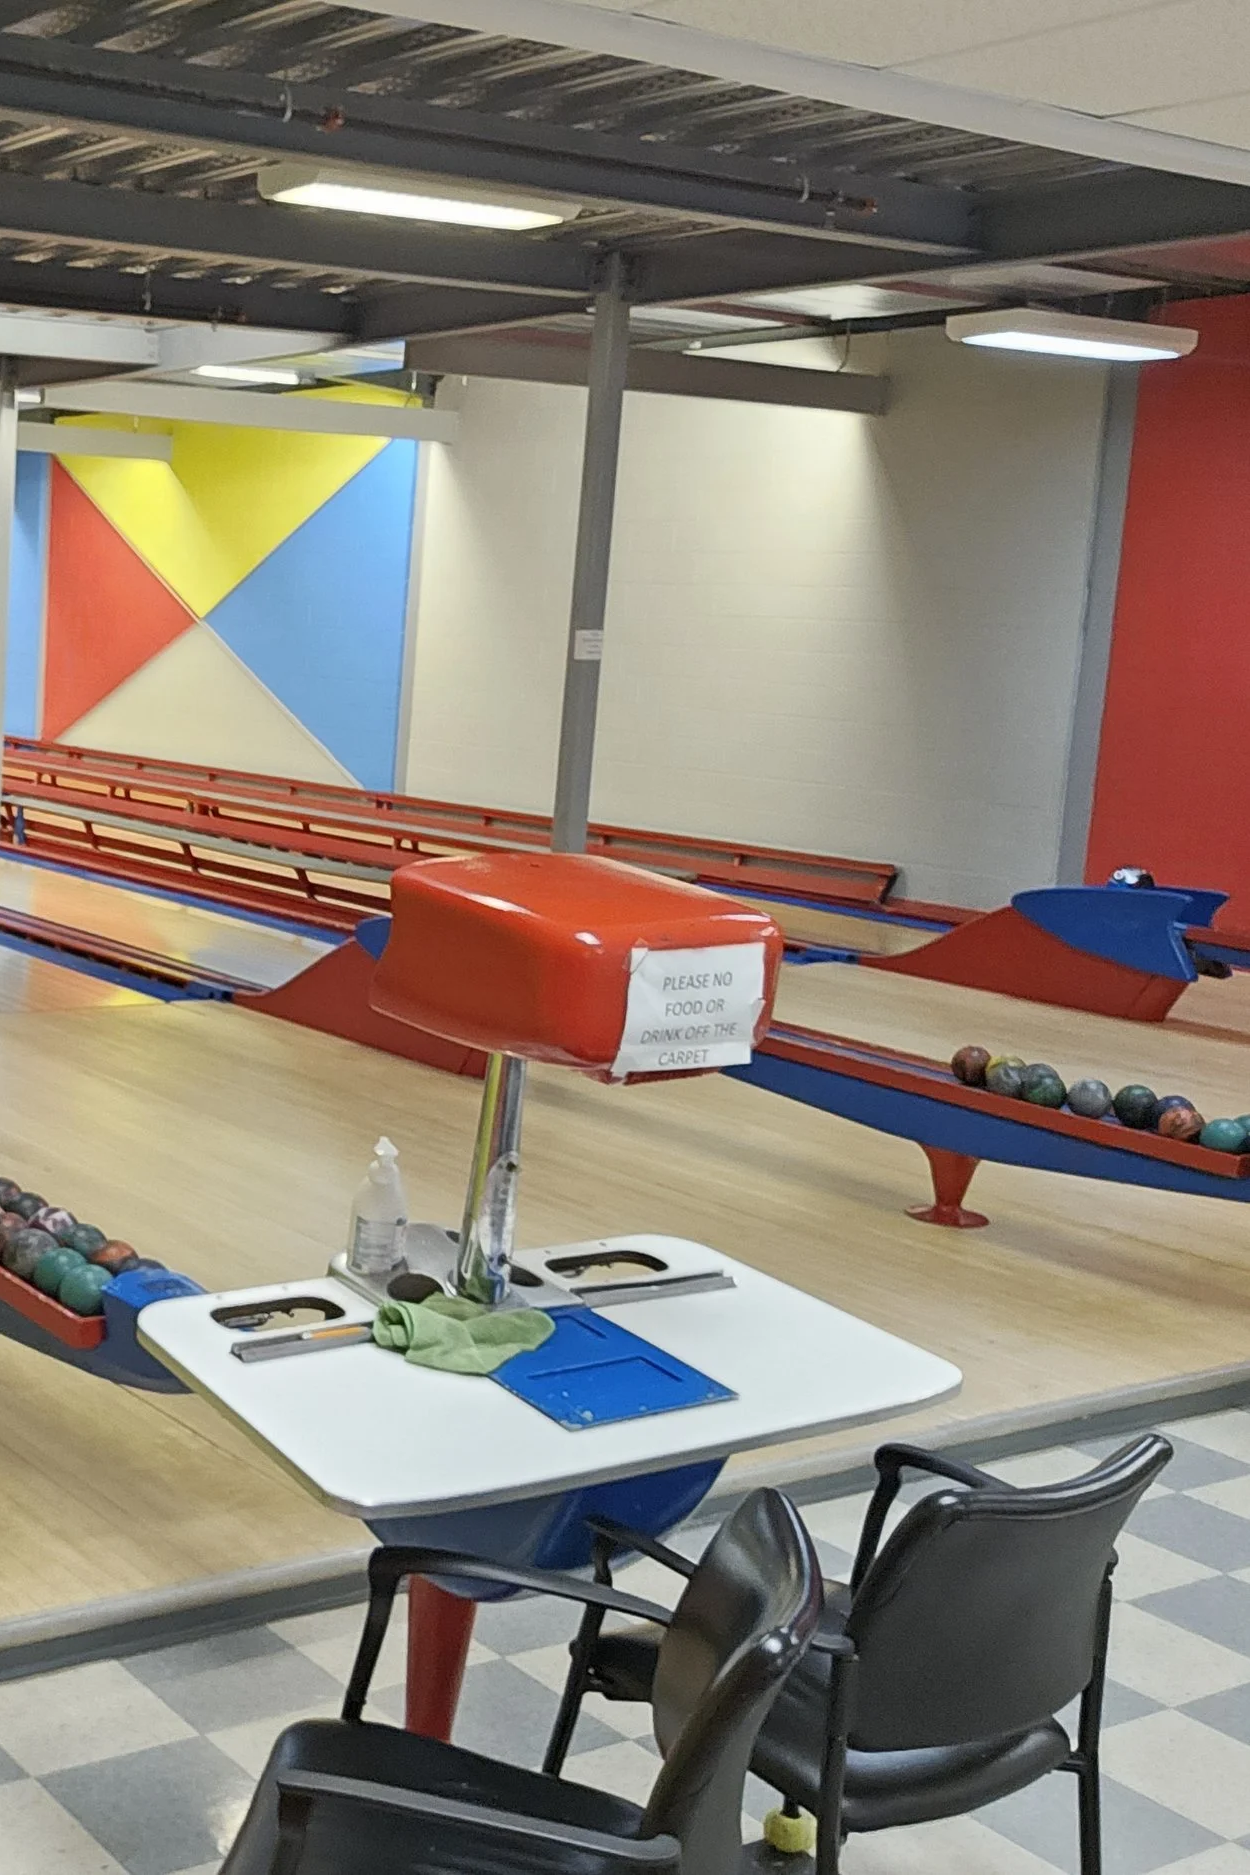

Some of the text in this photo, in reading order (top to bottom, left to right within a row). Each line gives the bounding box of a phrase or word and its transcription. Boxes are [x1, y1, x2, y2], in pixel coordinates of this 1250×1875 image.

[662, 971, 733, 991] PLEASE NO
[665, 999, 725, 1017] FOOD OR
[639, 1022, 738, 1045] DRINK OFF THE
[658, 1049, 709, 1067] CARPET
